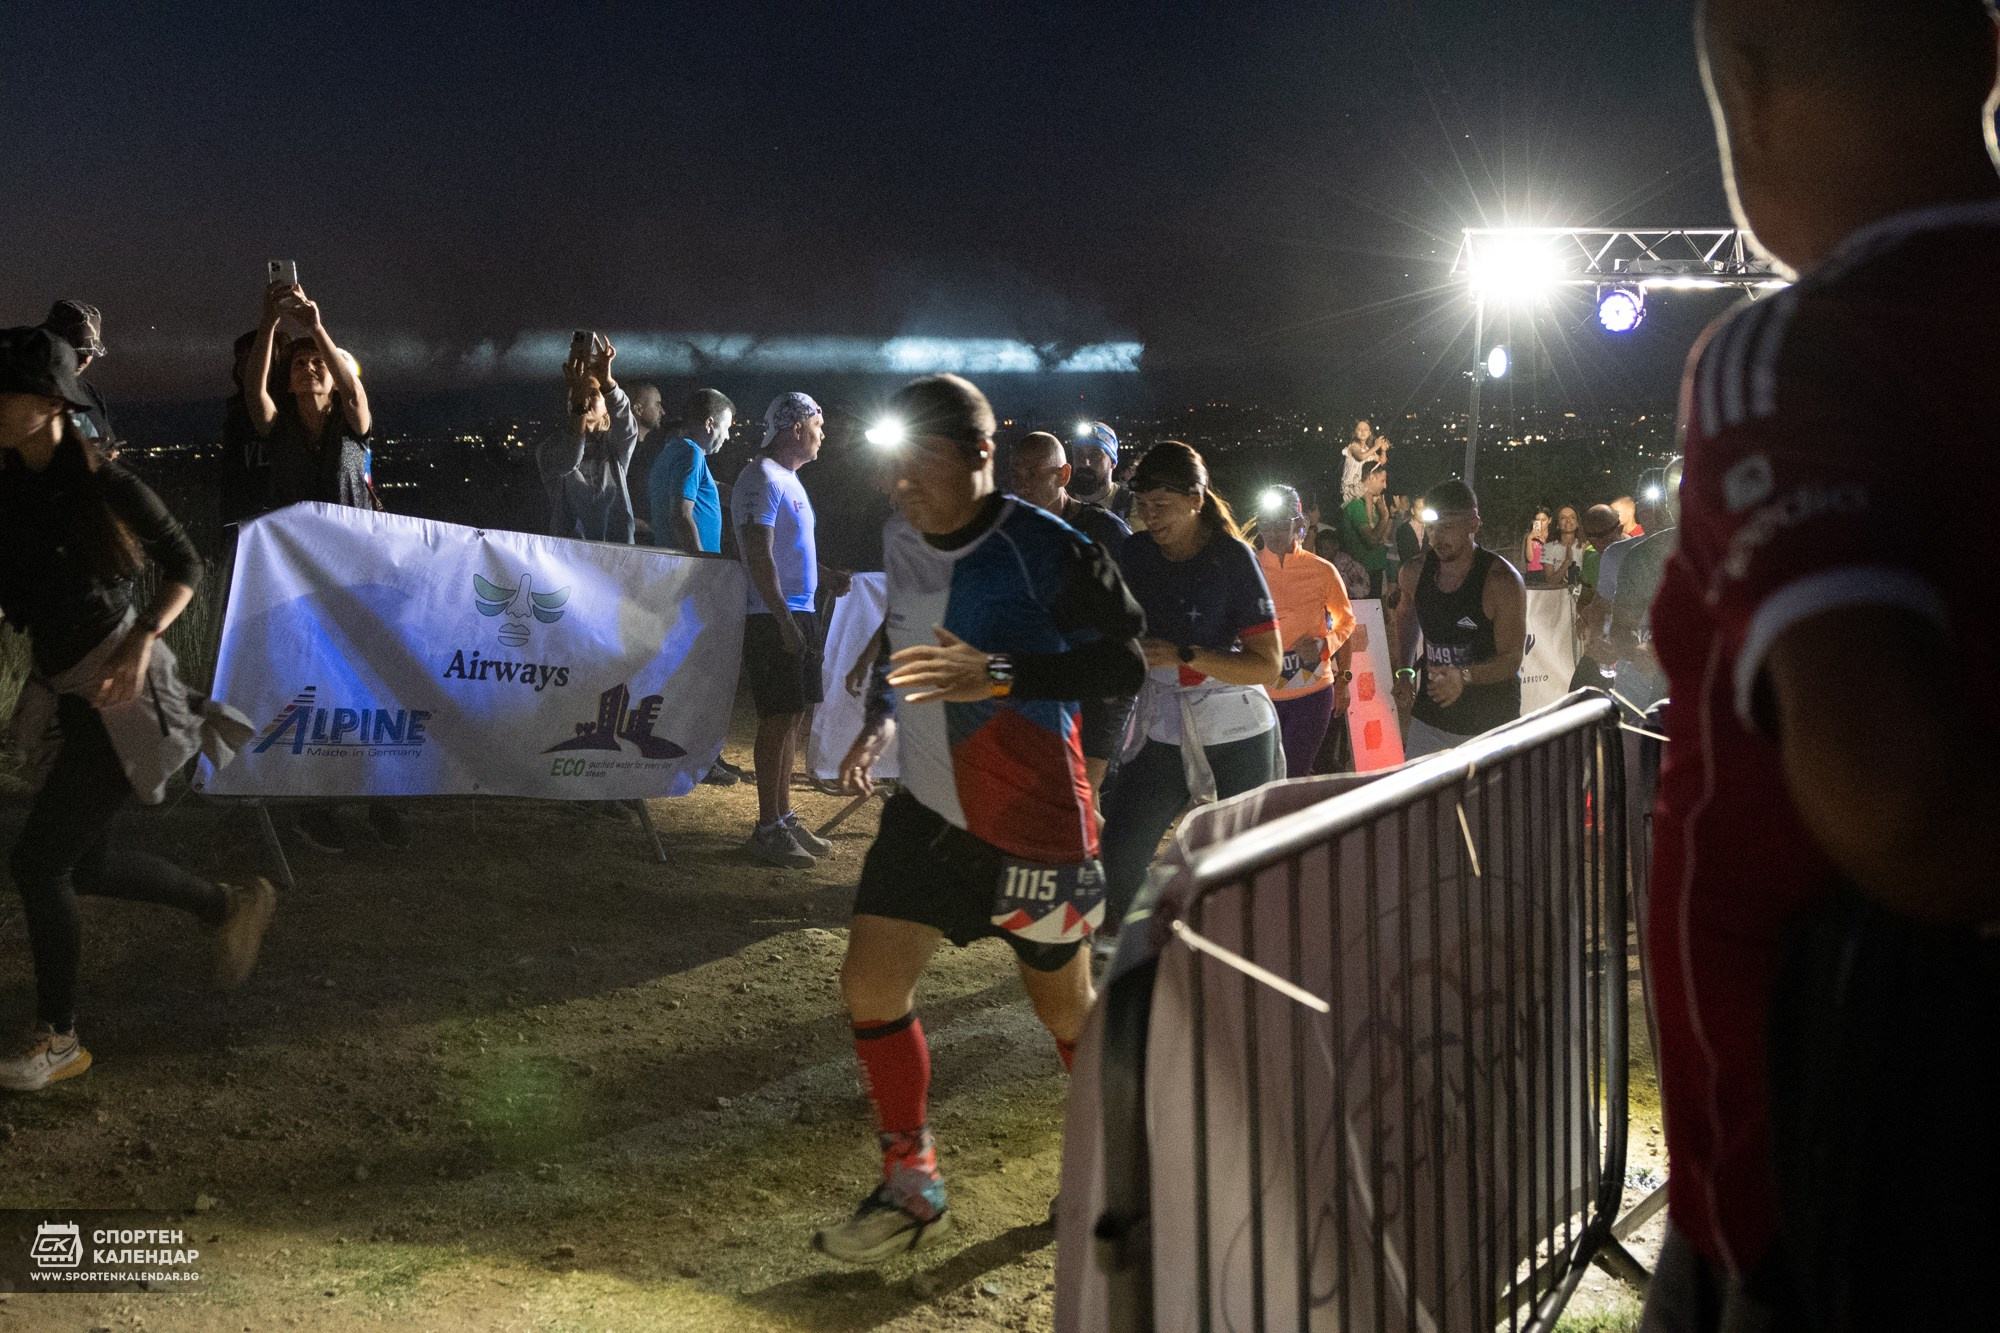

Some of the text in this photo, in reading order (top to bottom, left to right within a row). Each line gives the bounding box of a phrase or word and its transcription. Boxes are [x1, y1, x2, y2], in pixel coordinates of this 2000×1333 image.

[443, 649, 570, 692] Airways
[1521, 674, 1549, 685] ARKOVO
[252, 686, 432, 755] ALPINE
[306, 747, 422, 758] Made in Germany
[550, 758, 586, 777] ECO
[616, 761, 634, 769] water
[1004, 866, 1058, 901] 1115
